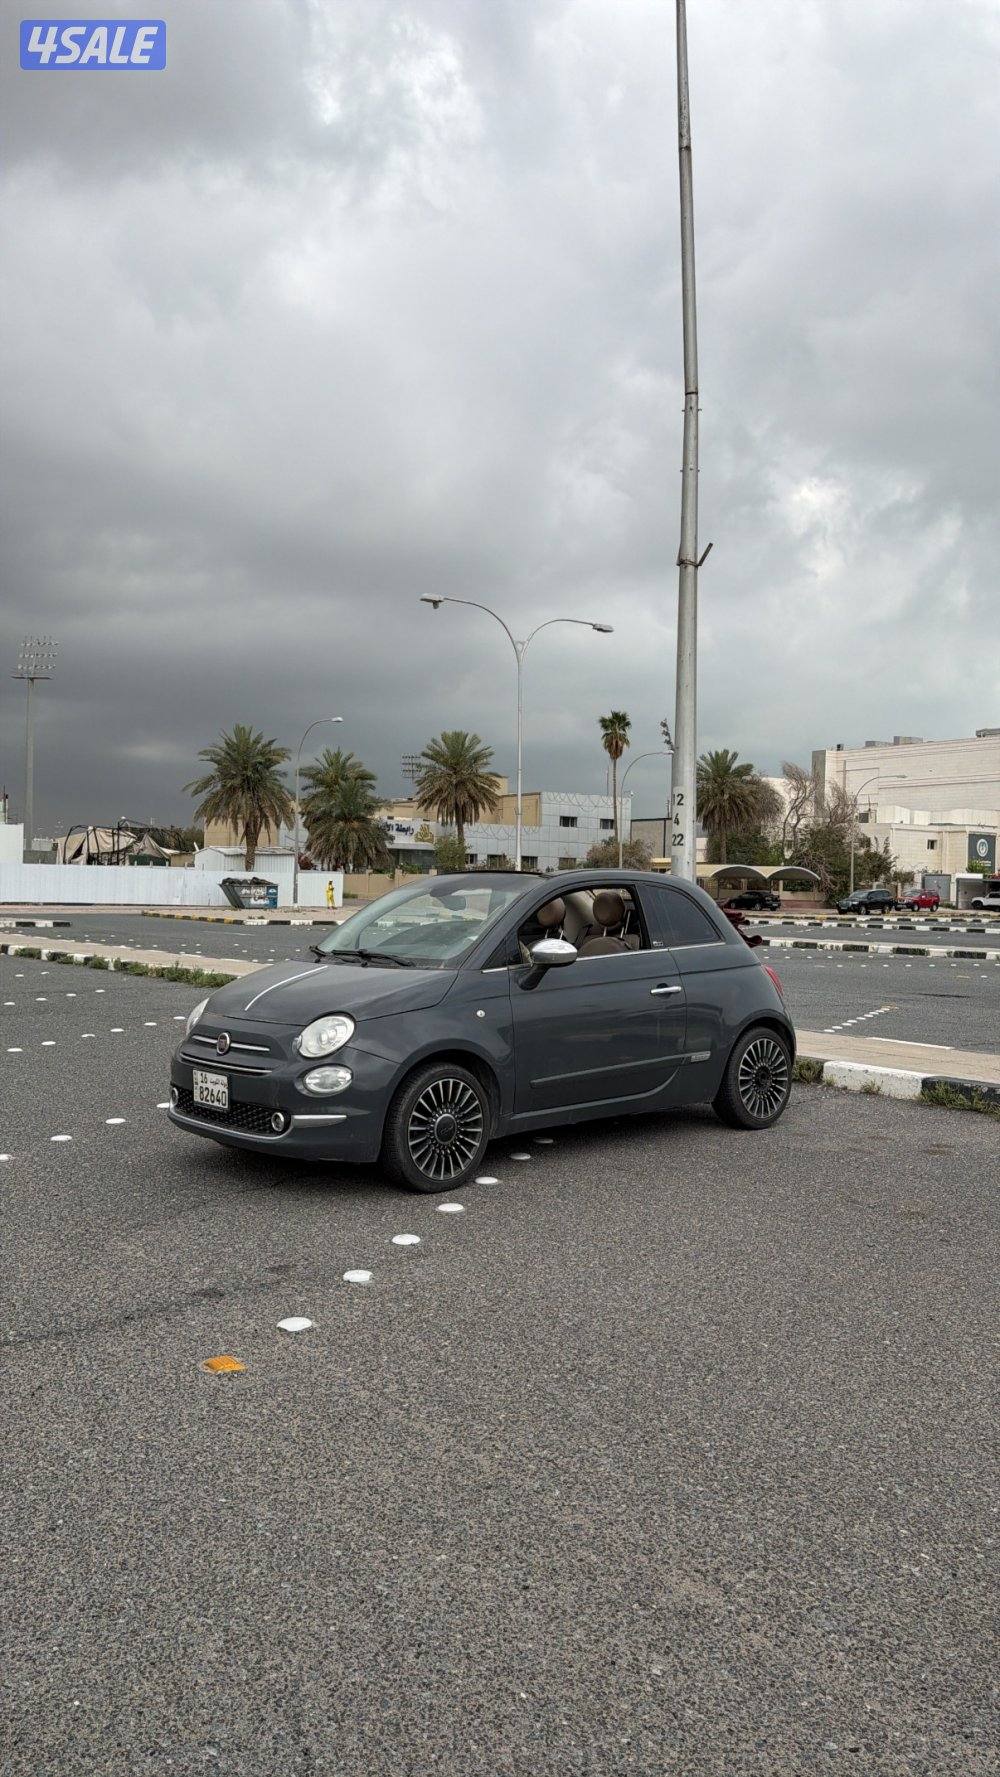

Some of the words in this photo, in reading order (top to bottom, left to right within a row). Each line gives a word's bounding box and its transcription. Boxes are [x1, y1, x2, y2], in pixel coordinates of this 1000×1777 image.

[673, 812, 680, 826] 4
[671, 833, 684, 847] 22
[200, 1072, 208, 1085] 16
[200, 1085, 227, 1107] 82640
